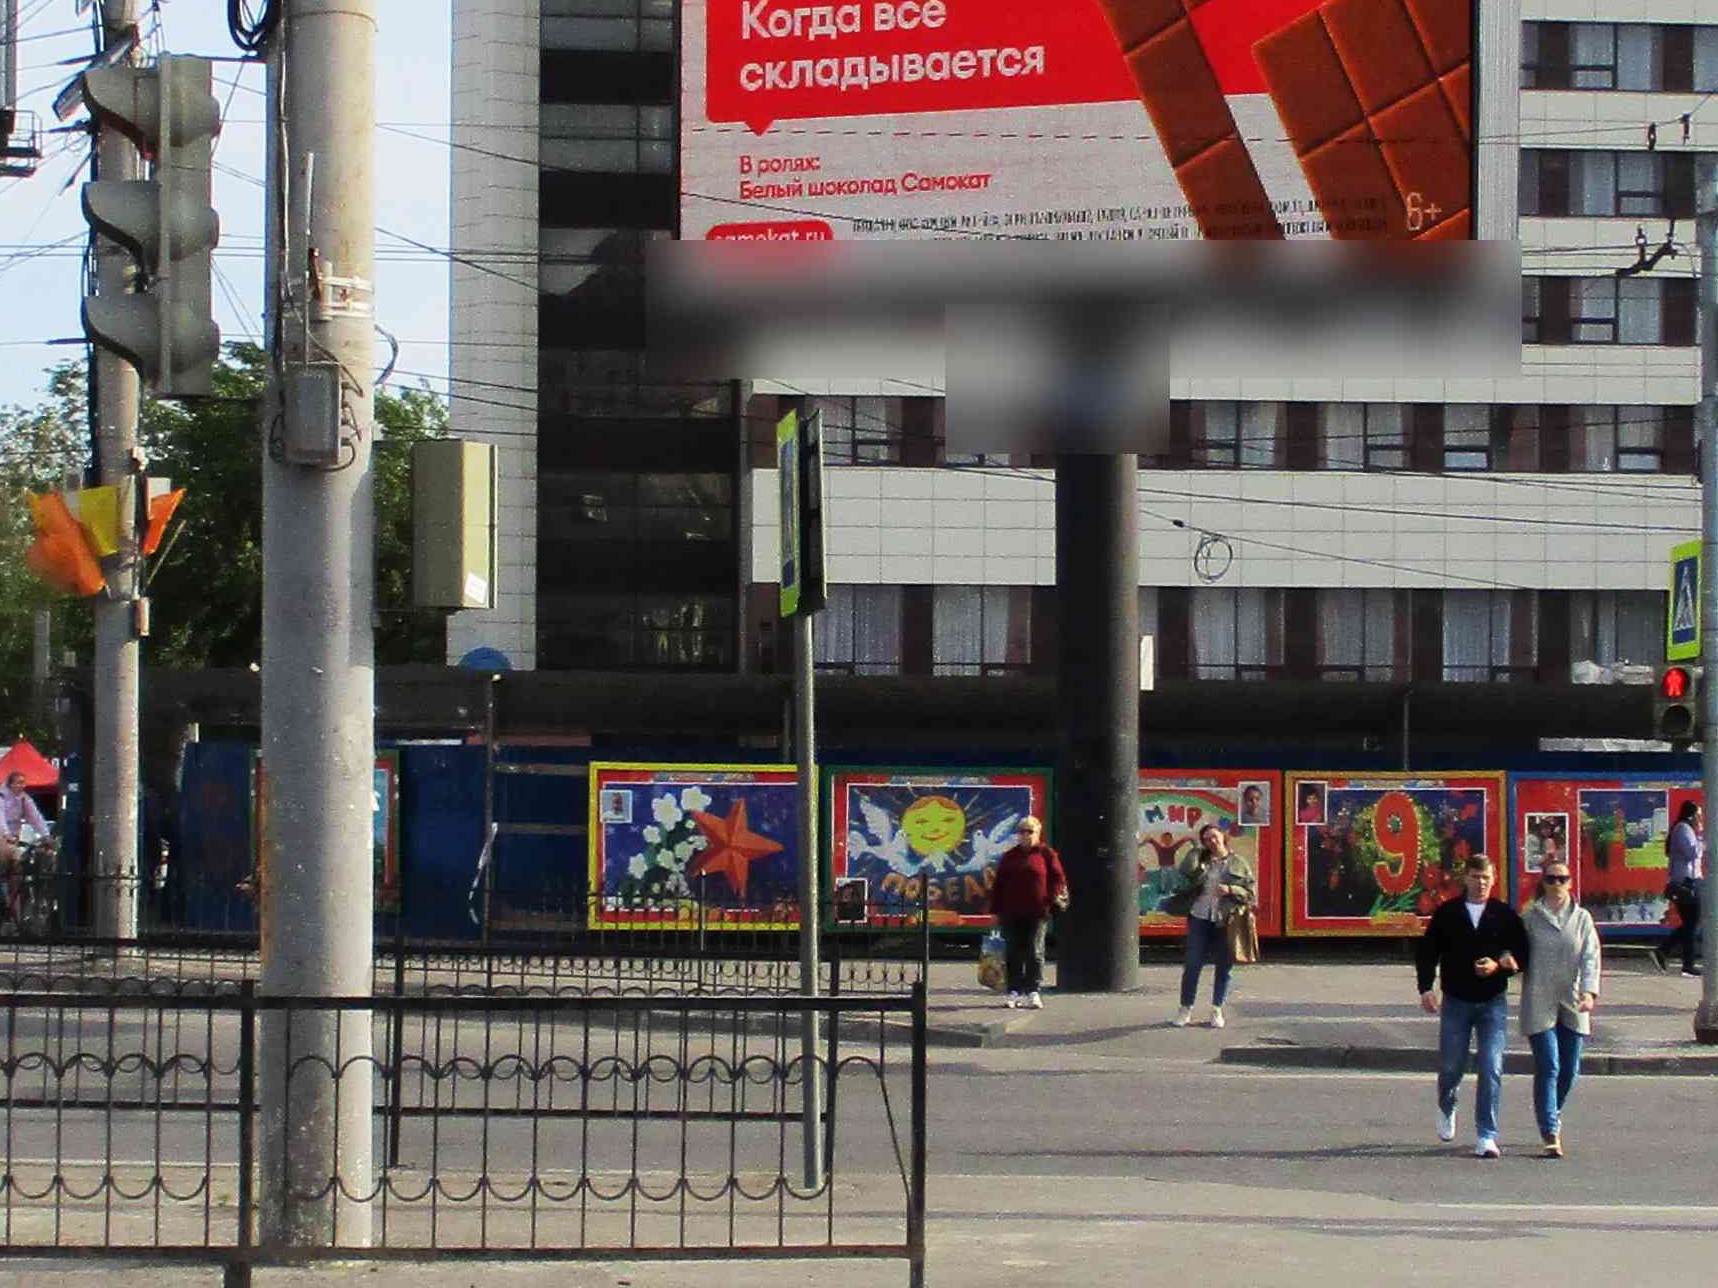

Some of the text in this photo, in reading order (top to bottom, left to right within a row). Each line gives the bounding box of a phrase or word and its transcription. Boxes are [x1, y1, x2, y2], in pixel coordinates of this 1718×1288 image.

[741, 0, 861, 41] Когда
[739, 45, 1044, 92] складывается
[740, 155, 821, 177] В ролях:
[740, 172, 992, 200] Белый шоколад Самокат
[1405, 192, 1442, 232] 6+
[1372, 792, 1421, 895] 9
